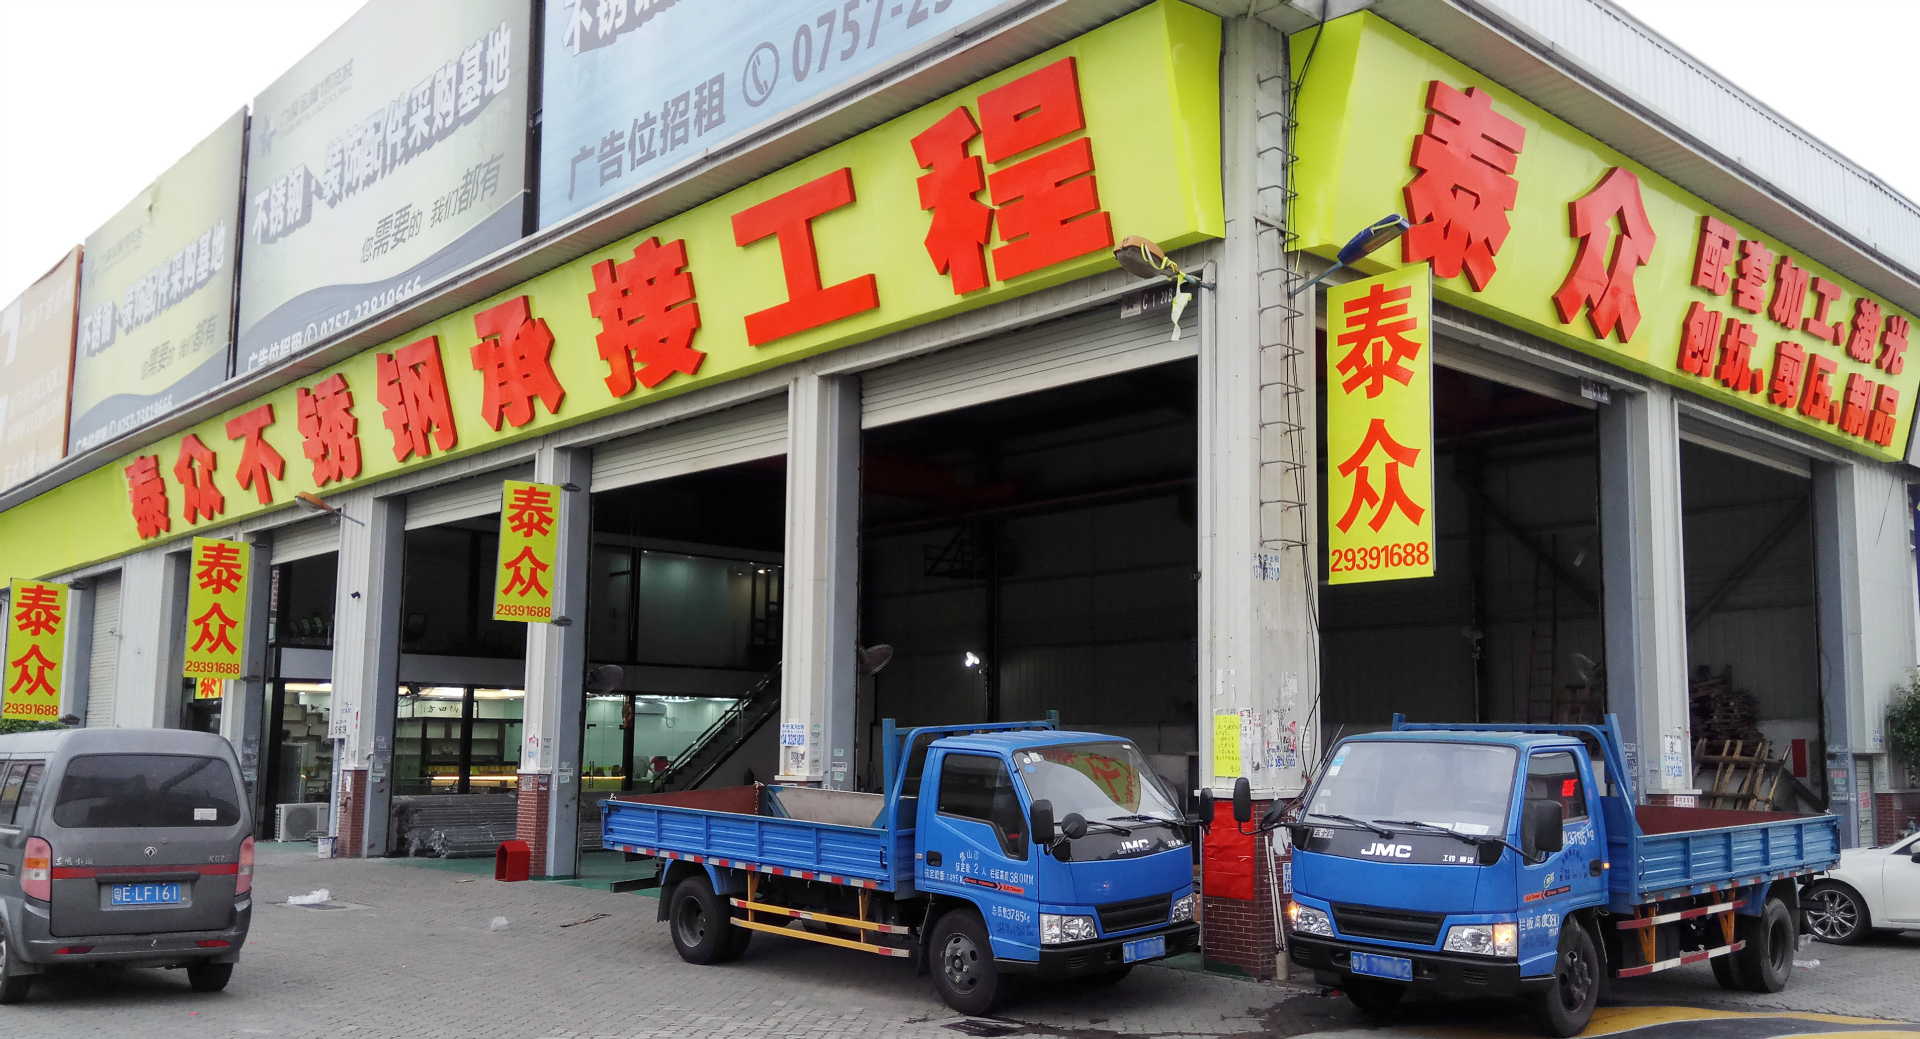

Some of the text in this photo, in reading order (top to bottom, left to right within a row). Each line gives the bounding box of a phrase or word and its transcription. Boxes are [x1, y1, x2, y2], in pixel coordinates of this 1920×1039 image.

[567, 0, 951, 200] 广告位招租 0757-2
[360, 152, 505, 263] 您需要的 我们都有
[1402, 80, 1657, 343] 泰众
[125, 56, 1115, 541] 泰众不锈钢承接工程
[1691, 215, 1910, 376] 配套加工、激光
[1335, 283, 1426, 534] 泰众
[502, 486, 554, 598] 泰众
[1330, 541, 1430, 573] 29391688
[9, 584, 61, 697] 泰众
[191, 543, 243, 655] 泰众
[496, 604, 551, 617] 29391688
[3, 702, 59, 716] 29391688
[185, 660, 240, 674] 29391688
[974, 863, 979, 874] 2
[1117, 839, 1150, 854] JMC
[1361, 843, 1412, 858] JMC
